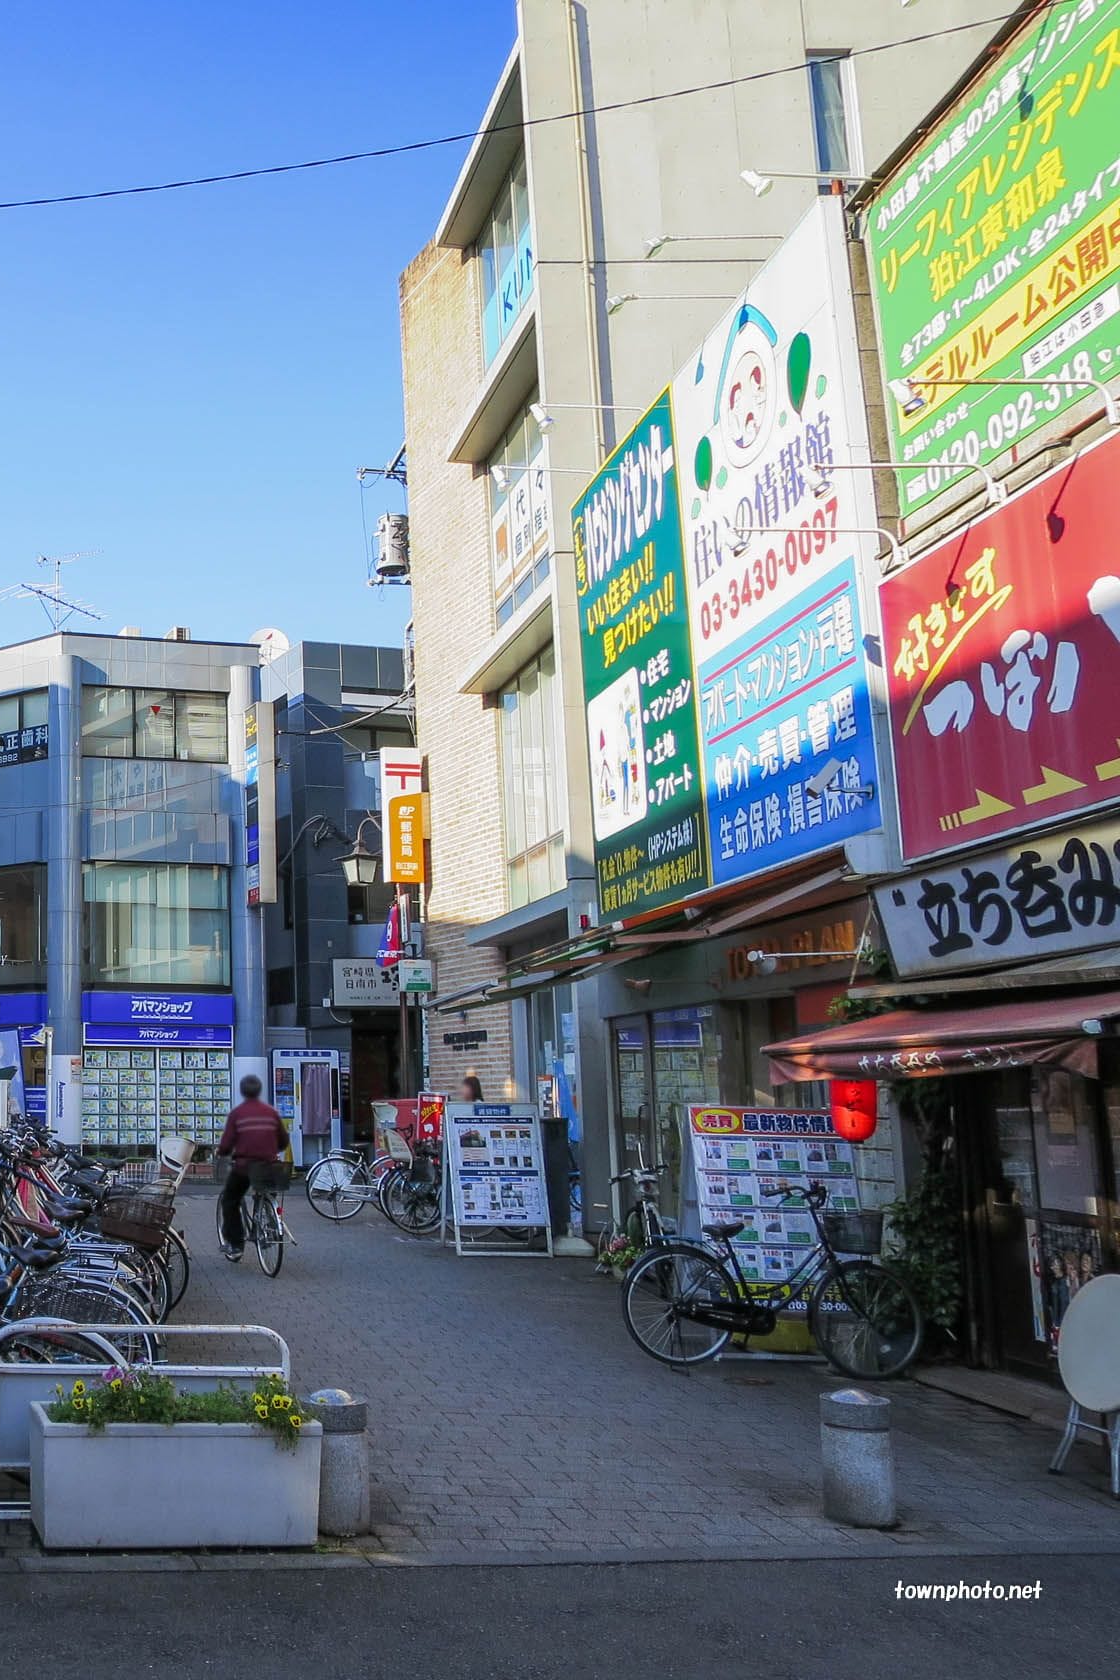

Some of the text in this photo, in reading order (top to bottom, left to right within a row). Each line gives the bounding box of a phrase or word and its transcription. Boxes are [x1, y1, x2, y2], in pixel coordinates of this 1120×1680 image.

[877, 0, 1104, 231] 小田急不動産の分譲マンショ
[881, 28, 1120, 293] リーフィアレジデンス
[929, 146, 1067, 302] 狛江東和泉
[907, 208, 1120, 403] デルルーム公開
[927, 351, 1092, 491] 0120-092-318
[584, 425, 674, 589] ハウジングセンター
[701, 496, 838, 640] 03-3430-0097
[587, 541, 655, 636] いい住まい!!
[604, 572, 674, 668] 見つけたい!!
[894, 546, 996, 682] 好きです
[714, 685, 857, 801] 仲介・売買・管理
[400, 821, 412, 857] 郵便局
[720, 756, 863, 861] 生命保険・損害保険
[131, 1000, 193, 1013] アパマンショップ
[139, 1029, 179, 1039] アパマンショップ
[702, 1113, 735, 1129] 売買
